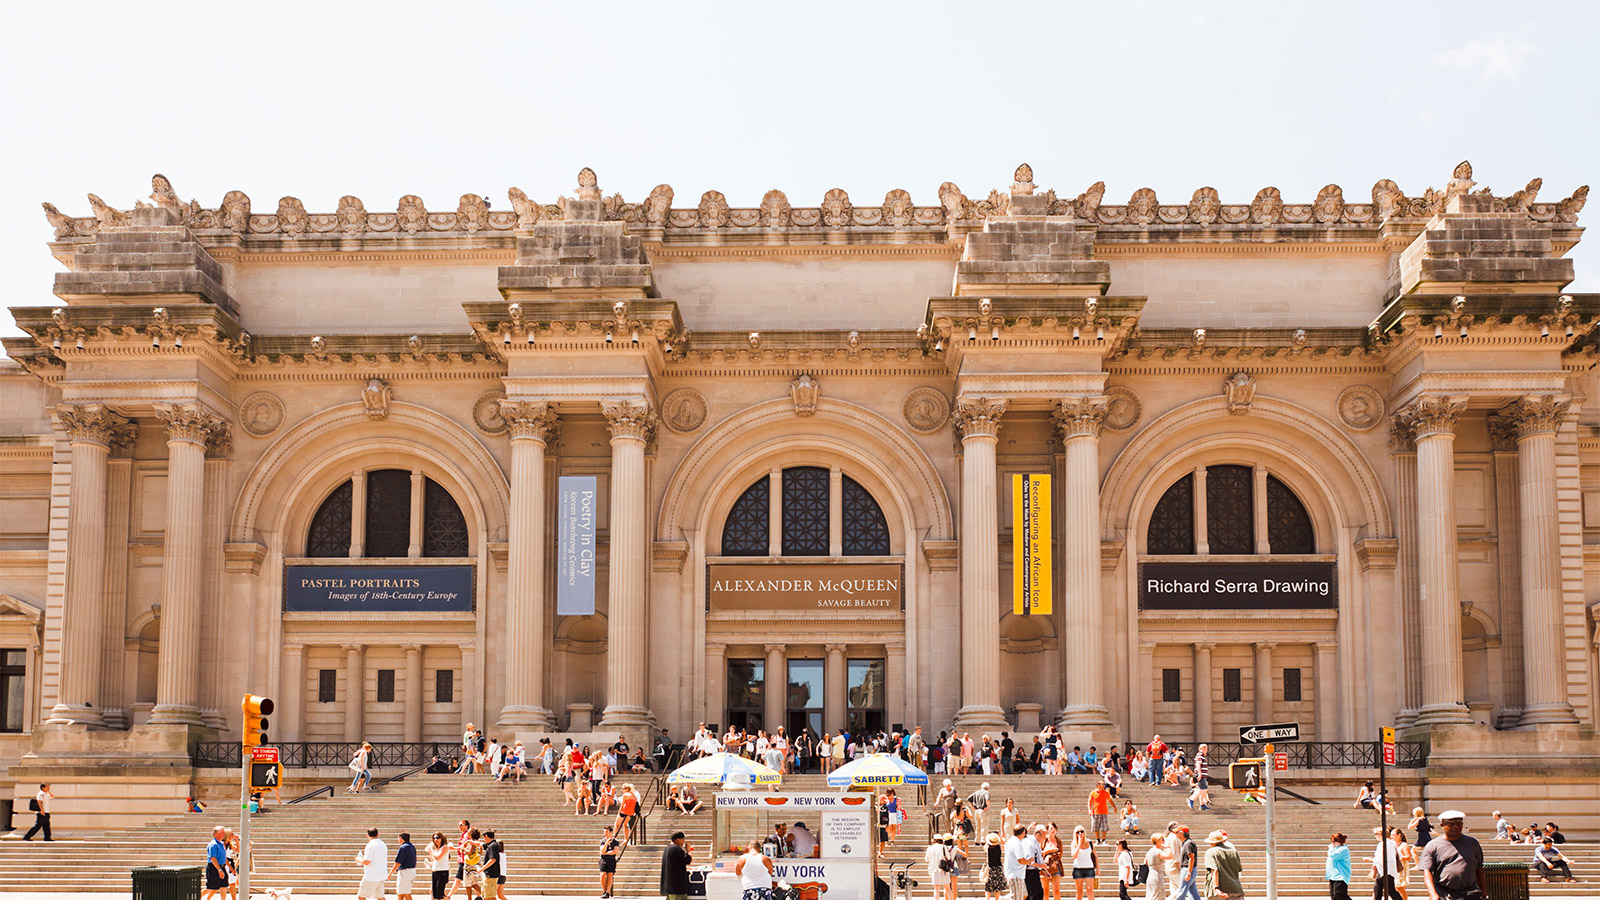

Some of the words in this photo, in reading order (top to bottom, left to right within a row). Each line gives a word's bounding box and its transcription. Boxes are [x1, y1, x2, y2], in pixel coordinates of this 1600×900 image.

[578, 491, 593, 530] Poetry
[1031, 481, 1040, 540] Reconfiguring
[568, 517, 577, 554] Buncheong
[581, 534, 592, 545] in
[1033, 543, 1039, 553] an
[577, 549, 593, 577] Clay
[301, 579, 346, 588] PASTEL
[350, 579, 420, 588] PORTRAITS
[713, 580, 814, 592] ALEXANDER
[818, 580, 898, 594] McQUEEN
[1147, 580, 1210, 593] Richard
[1215, 579, 1258, 593] Serra
[1263, 579, 1329, 595] Drawing
[328, 592, 357, 601] Images
[360, 591, 370, 601] of
[371, 592, 425, 601] 18th-Century
[427, 592, 458, 601] Europe
[792, 866, 825, 877] YORK
